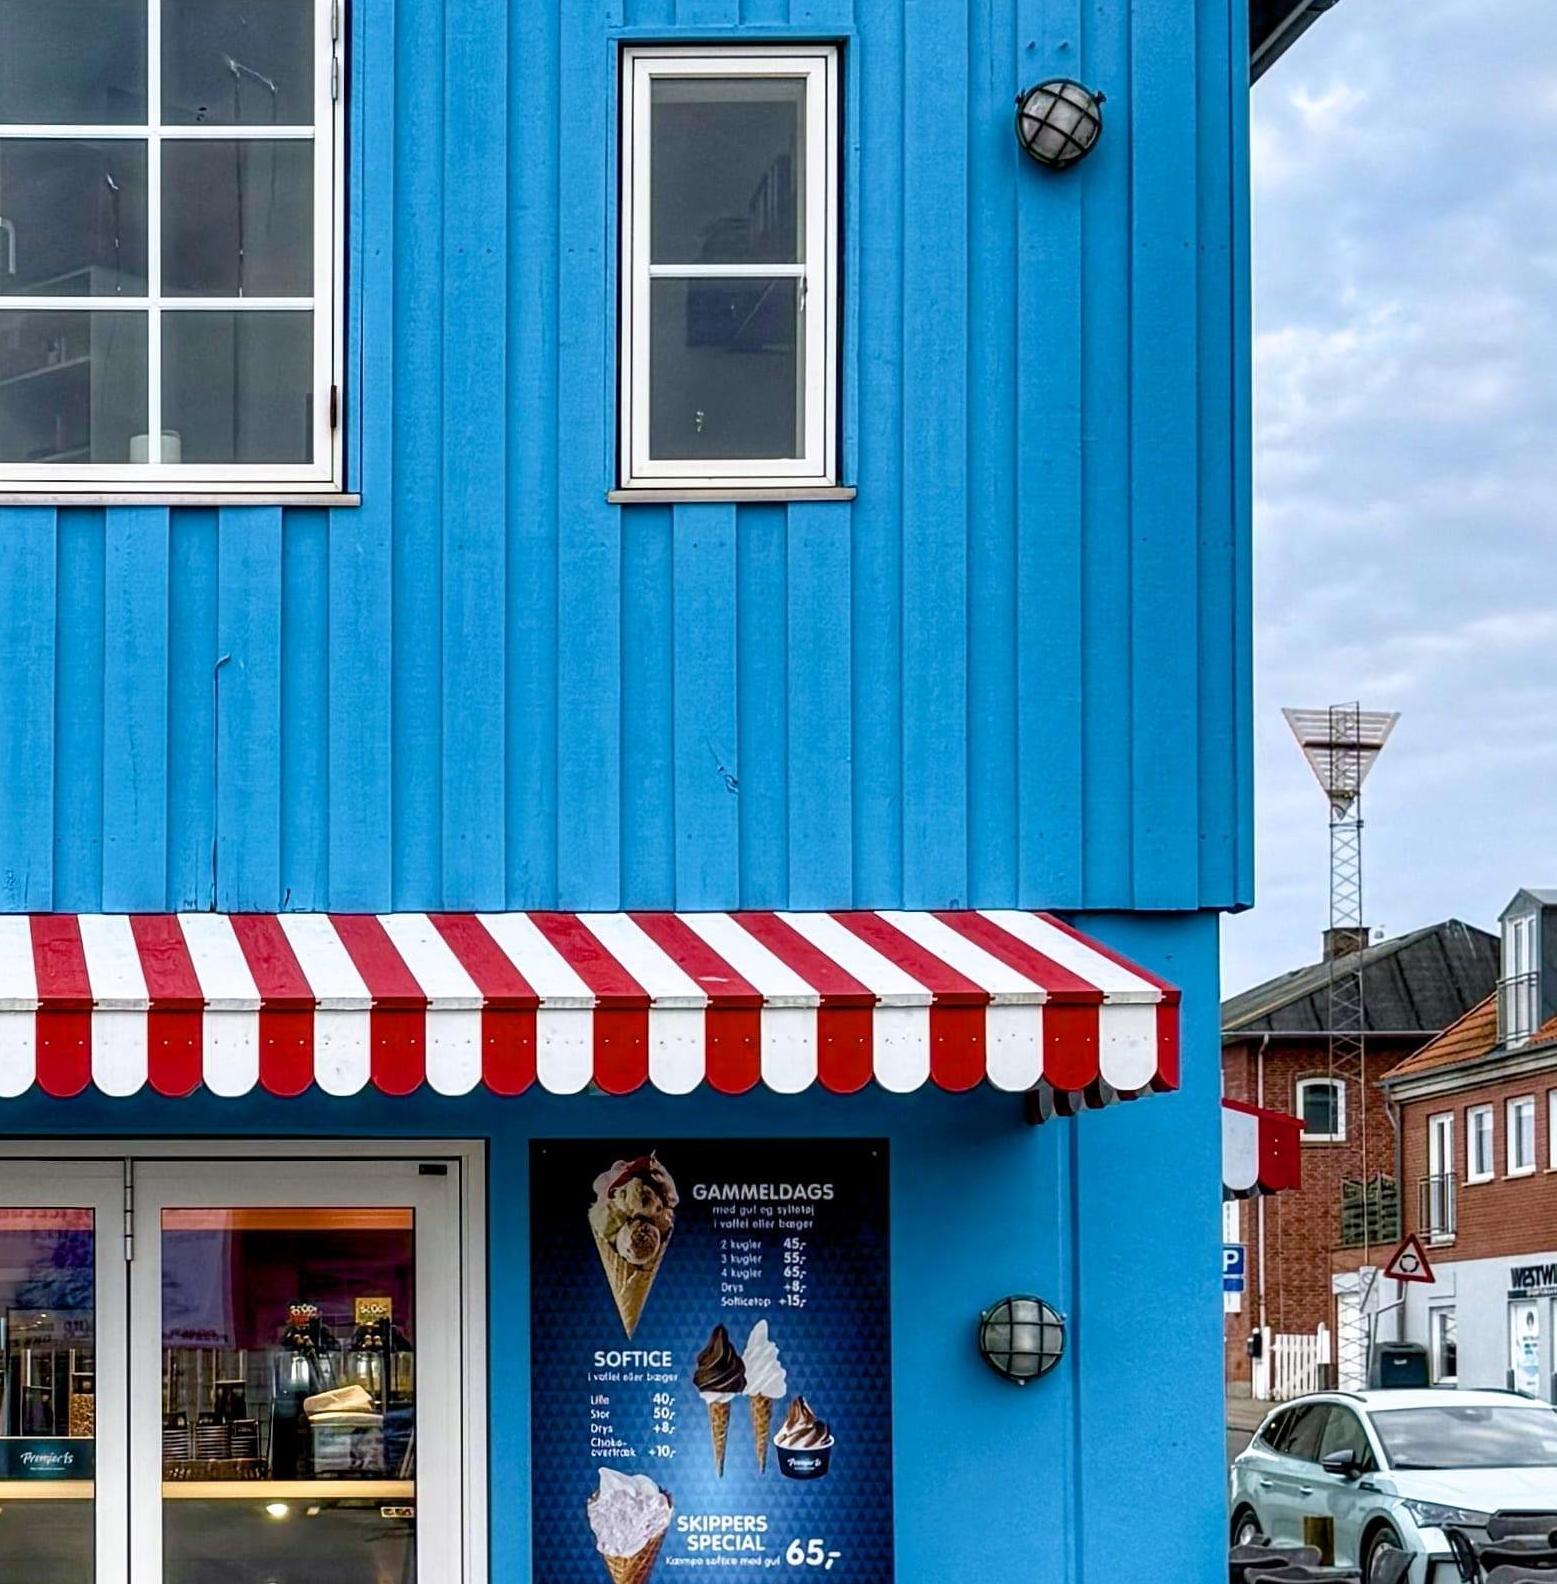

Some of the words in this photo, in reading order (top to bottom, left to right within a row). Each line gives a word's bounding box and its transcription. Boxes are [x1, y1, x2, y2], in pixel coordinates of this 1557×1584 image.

[692, 1183, 835, 1201] GAMMELDAGS
[721, 1239, 727, 1250] 2
[731, 1239, 762, 1251] kugler
[783, 1237, 807, 1251] 45,-
[721, 1253, 727, 1264] 3
[731, 1253, 762, 1266] kugler
[783, 1251, 807, 1265] 55,-
[1223, 1249, 1239, 1273] P
[721, 1268, 727, 1278] 4
[731, 1267, 762, 1280] kugler
[783, 1266, 807, 1280] 65,-
[783, 1280, 807, 1294] +8,-
[778, 1294, 807, 1308] +15,-
[594, 1350, 672, 1367] SOFTICE
[653, 1392, 675, 1406] 40,-
[653, 1407, 675, 1420] 50,-
[590, 1423, 613, 1435] Drys
[652, 1421, 675, 1434] +8,-
[648, 1445, 676, 1458] +10,-
[677, 1515, 768, 1532] SKIPPERS
[687, 1534, 766, 1551] SPECIAL
[786, 1538, 841, 1570] 65,-
